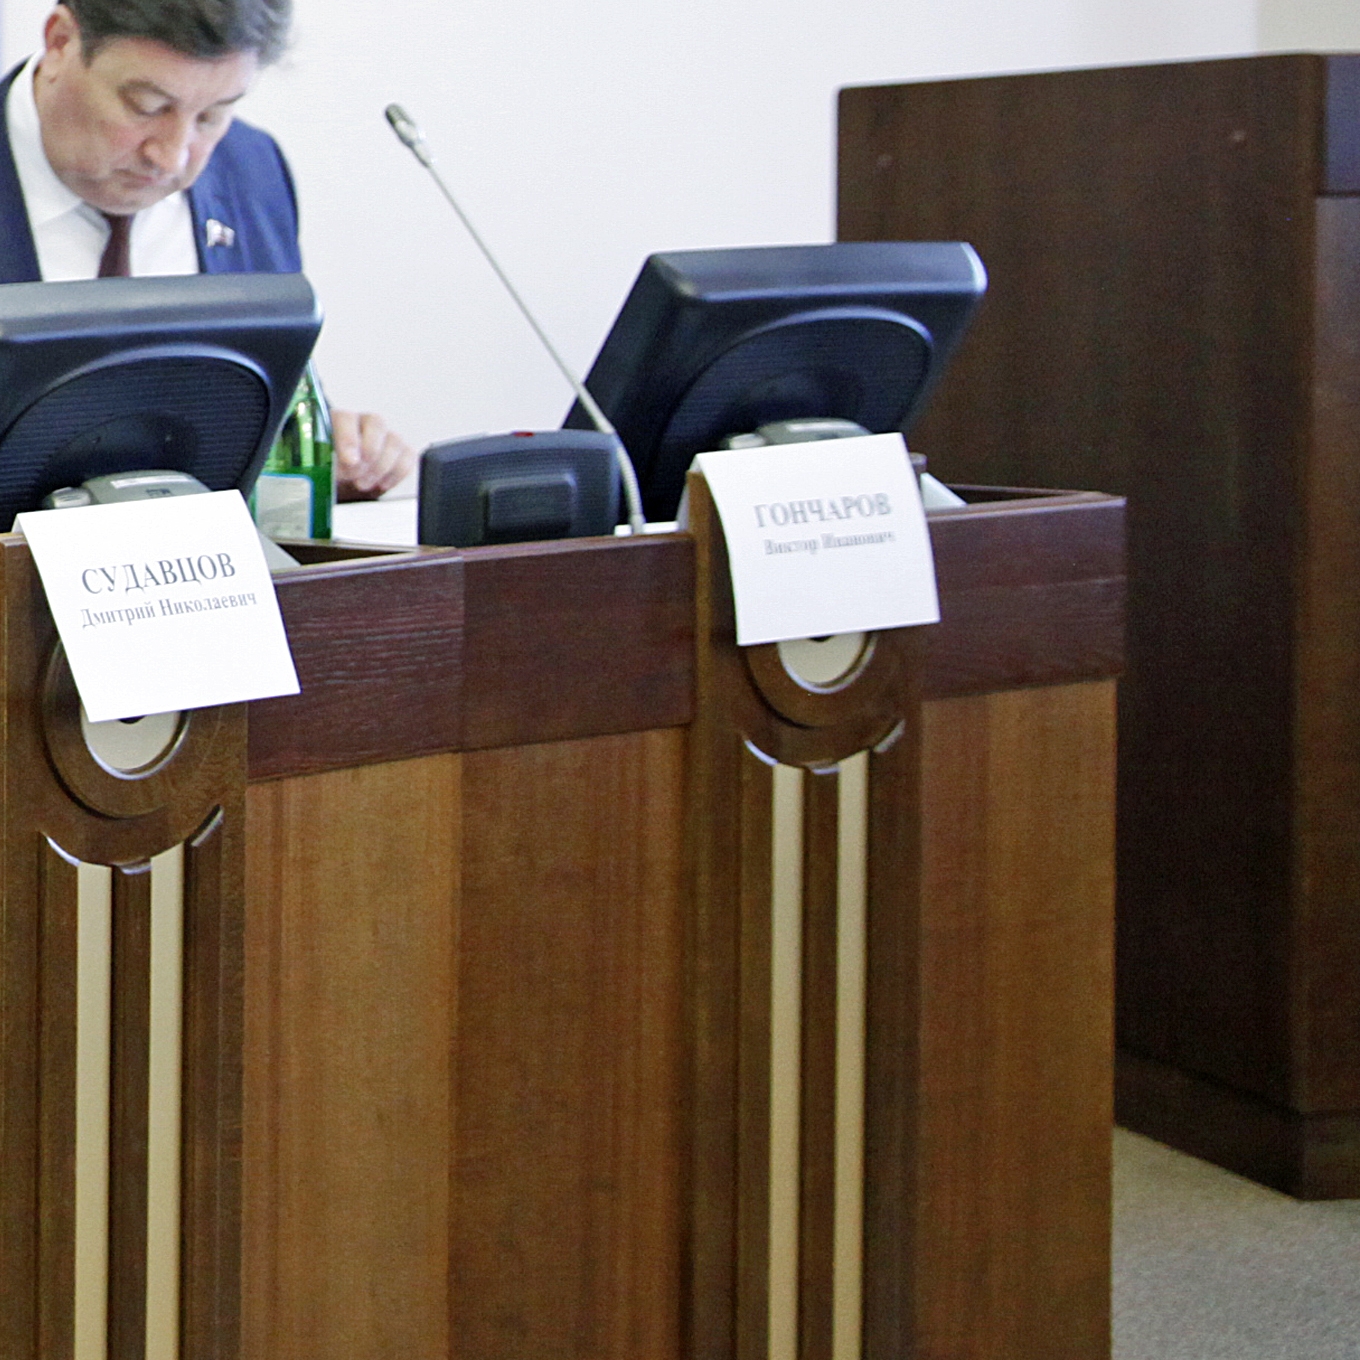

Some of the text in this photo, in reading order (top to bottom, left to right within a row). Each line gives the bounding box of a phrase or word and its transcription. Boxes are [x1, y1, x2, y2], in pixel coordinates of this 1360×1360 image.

[753, 492, 892, 528] ГОНЧАРОВ
[81, 552, 236, 594] СУДАВЦОВ
[80, 592, 258, 629] Дмитрий Николаевич
